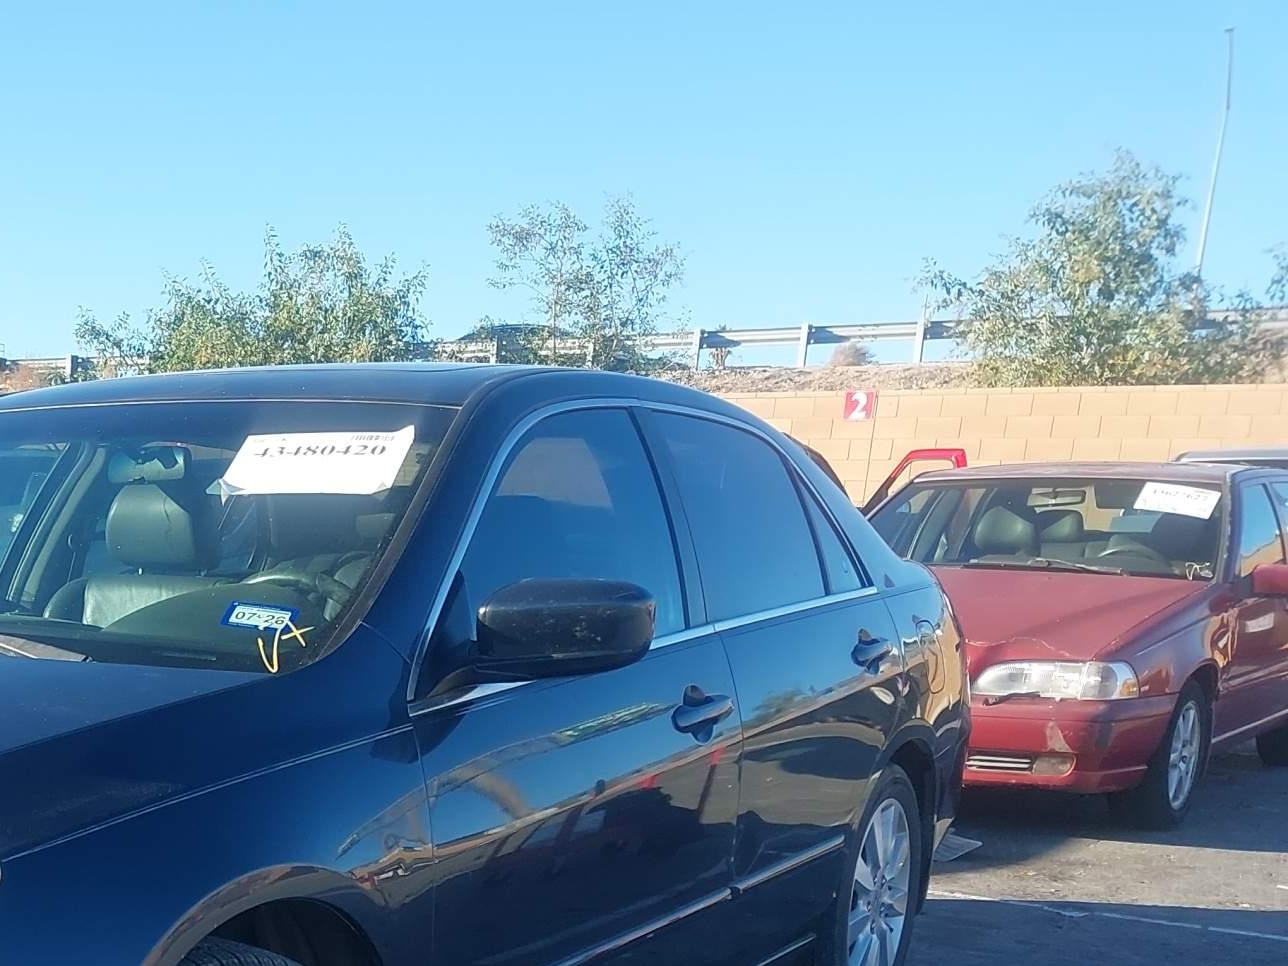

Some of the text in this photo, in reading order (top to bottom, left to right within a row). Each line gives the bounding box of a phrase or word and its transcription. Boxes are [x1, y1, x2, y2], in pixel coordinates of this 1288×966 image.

[846, 391, 868, 421] 2
[253, 445, 387, 457] 43480420
[235, 611, 286, 625] 07 26
